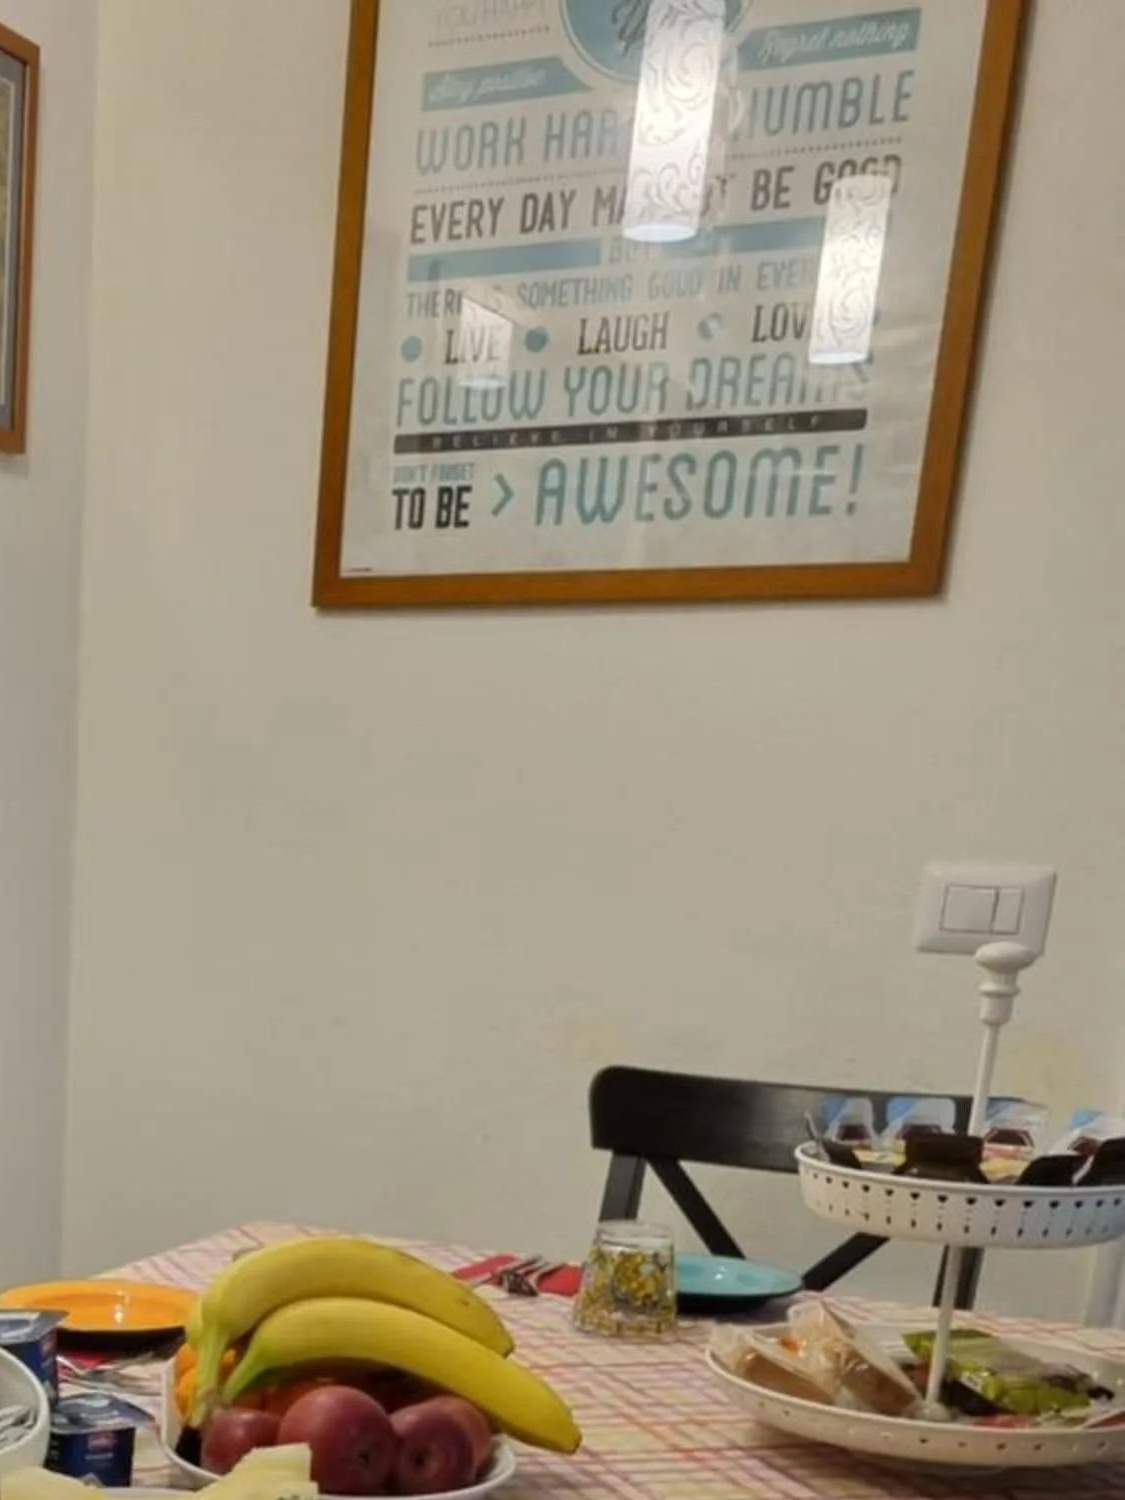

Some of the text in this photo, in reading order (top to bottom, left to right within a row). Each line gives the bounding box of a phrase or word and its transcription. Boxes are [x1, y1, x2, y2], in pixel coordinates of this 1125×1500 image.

[415, 114, 526, 175] WORK
[543, 107, 633, 163] HAR
[410, 195, 505, 245] EVERY
[519, 188, 577, 235] DAY
[749, 164, 795, 213] BE
[406, 287, 465, 319] THER
[516, 273, 633, 311] SOMETHING
[717, 263, 742, 295] IN
[576, 311, 670, 357] LAUGH
[751, 301, 813, 345] LOV
[395, 367, 547, 428] FOLLOW
[563, 359, 669, 418] YOUR
[391, 484, 474, 531] TO BE
[534, 443, 865, 528] AWESOME!
